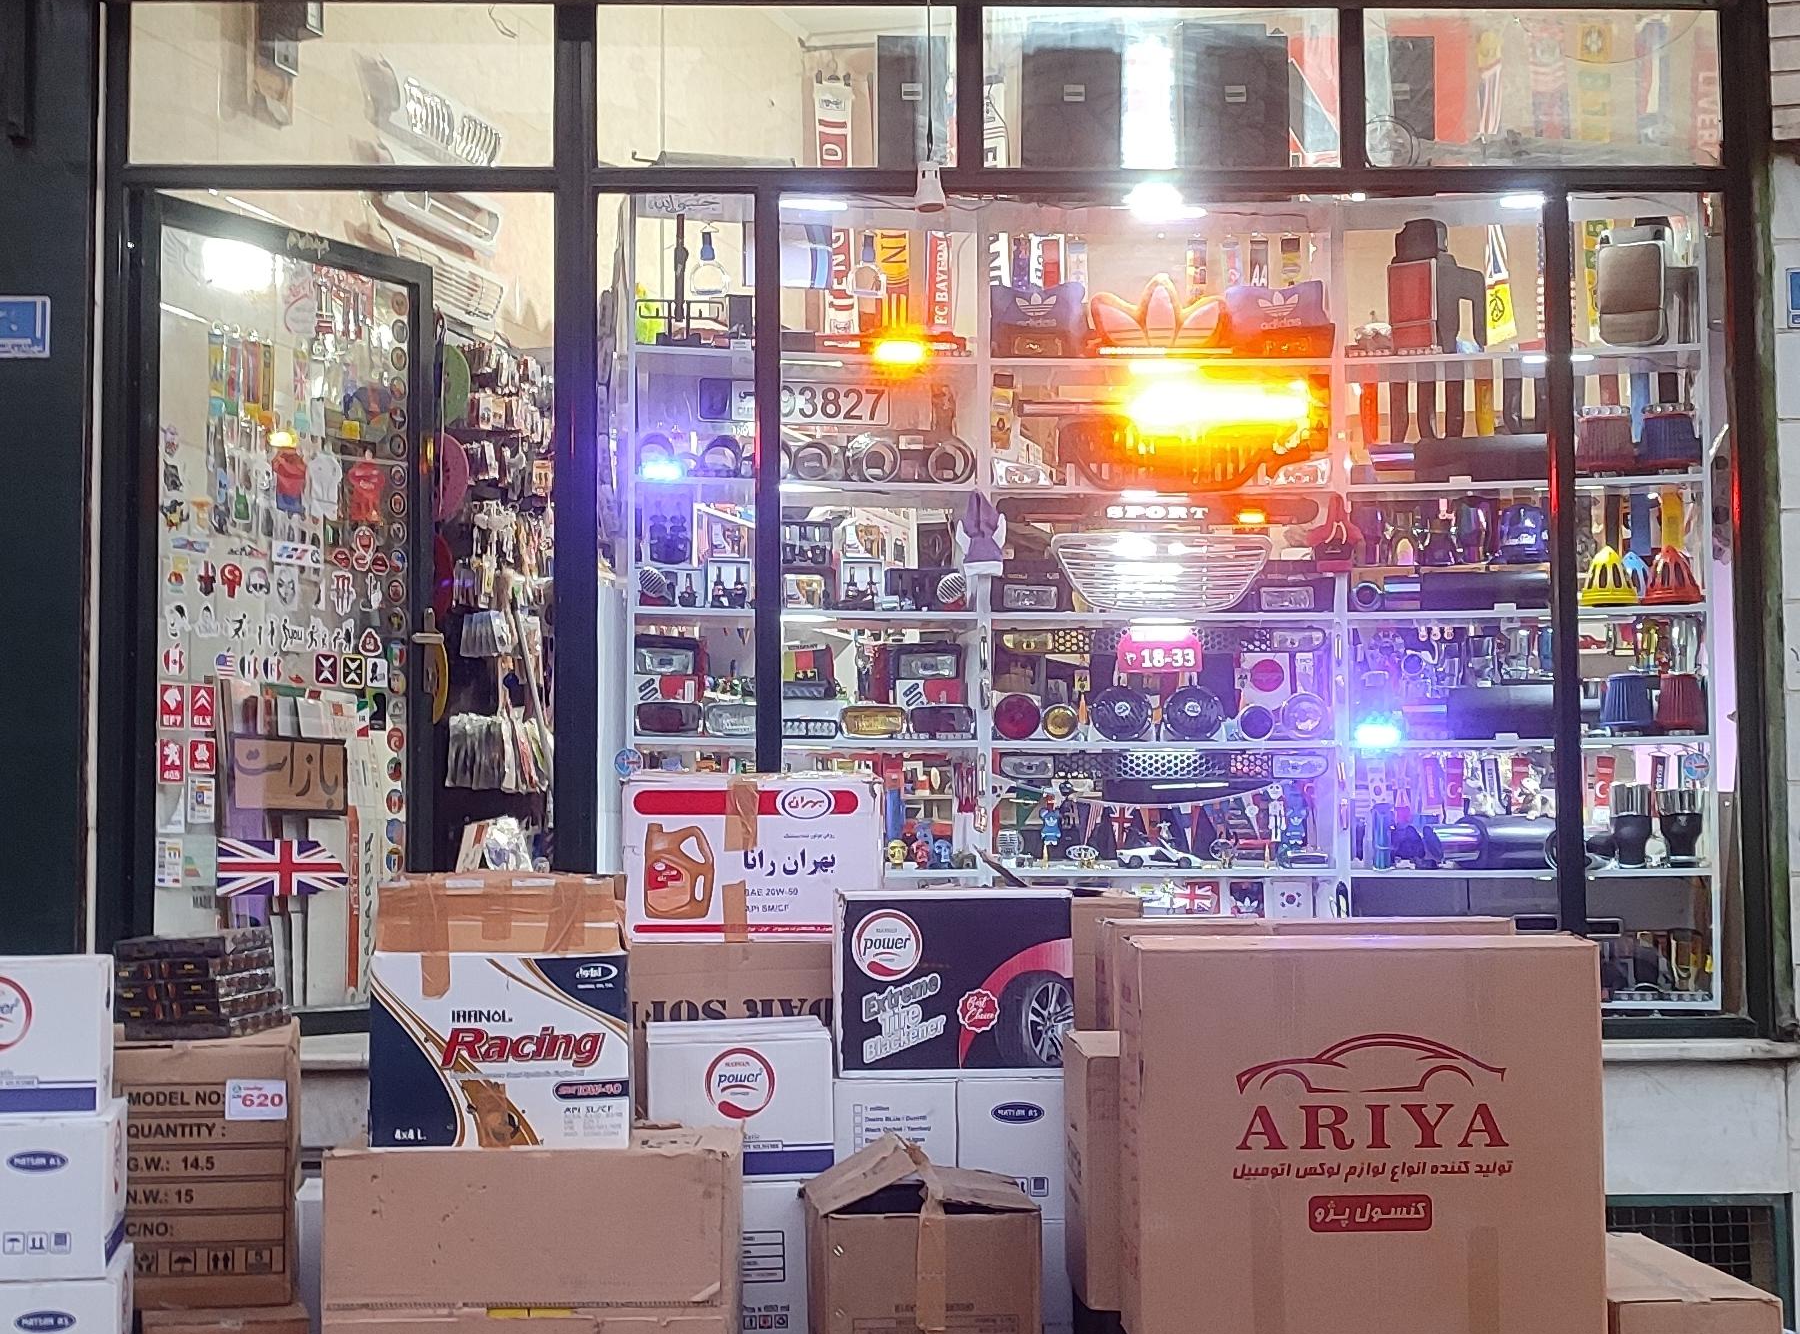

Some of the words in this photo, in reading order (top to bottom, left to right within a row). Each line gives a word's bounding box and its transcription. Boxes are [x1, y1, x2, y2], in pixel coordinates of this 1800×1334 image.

[934, 306, 949, 325] FC
[1106, 505, 1210, 519] SPORT
[743, 849, 776, 877] رانا
[782, 848, 836, 876] بهران
[863, 937, 911, 956] power
[864, 975, 940, 1018] Extreme
[440, 1025, 606, 1068] Racing
[864, 1017, 946, 1062] Blackener
[717, 1071, 762, 1087] power
[128, 1091, 190, 1107] MODEL
[241, 1093, 284, 1108] 620
[127, 1123, 216, 1139] QUANTITY
[394, 1128, 415, 1140] 4x4
[1235, 1103, 1510, 1151] ARIYA
[181, 1156, 215, 1171] 14.5
[1233, 1163, 1291, 1181] اتومبیل
[1295, 1162, 1341, 1180] لوکس
[1343, 1161, 1387, 1183] لوازم
[1390, 1160, 1426, 1183] انواع
[1430, 1160, 1471, 1177] کننده
[1474, 1160, 1514, 1179] تولید
[175, 1189, 194, 1204] 15
[1314, 1199, 1352, 1228] پژو
[1354, 1201, 1427, 1224] کنسول
[125, 1222, 174, 1238] C/NO:
